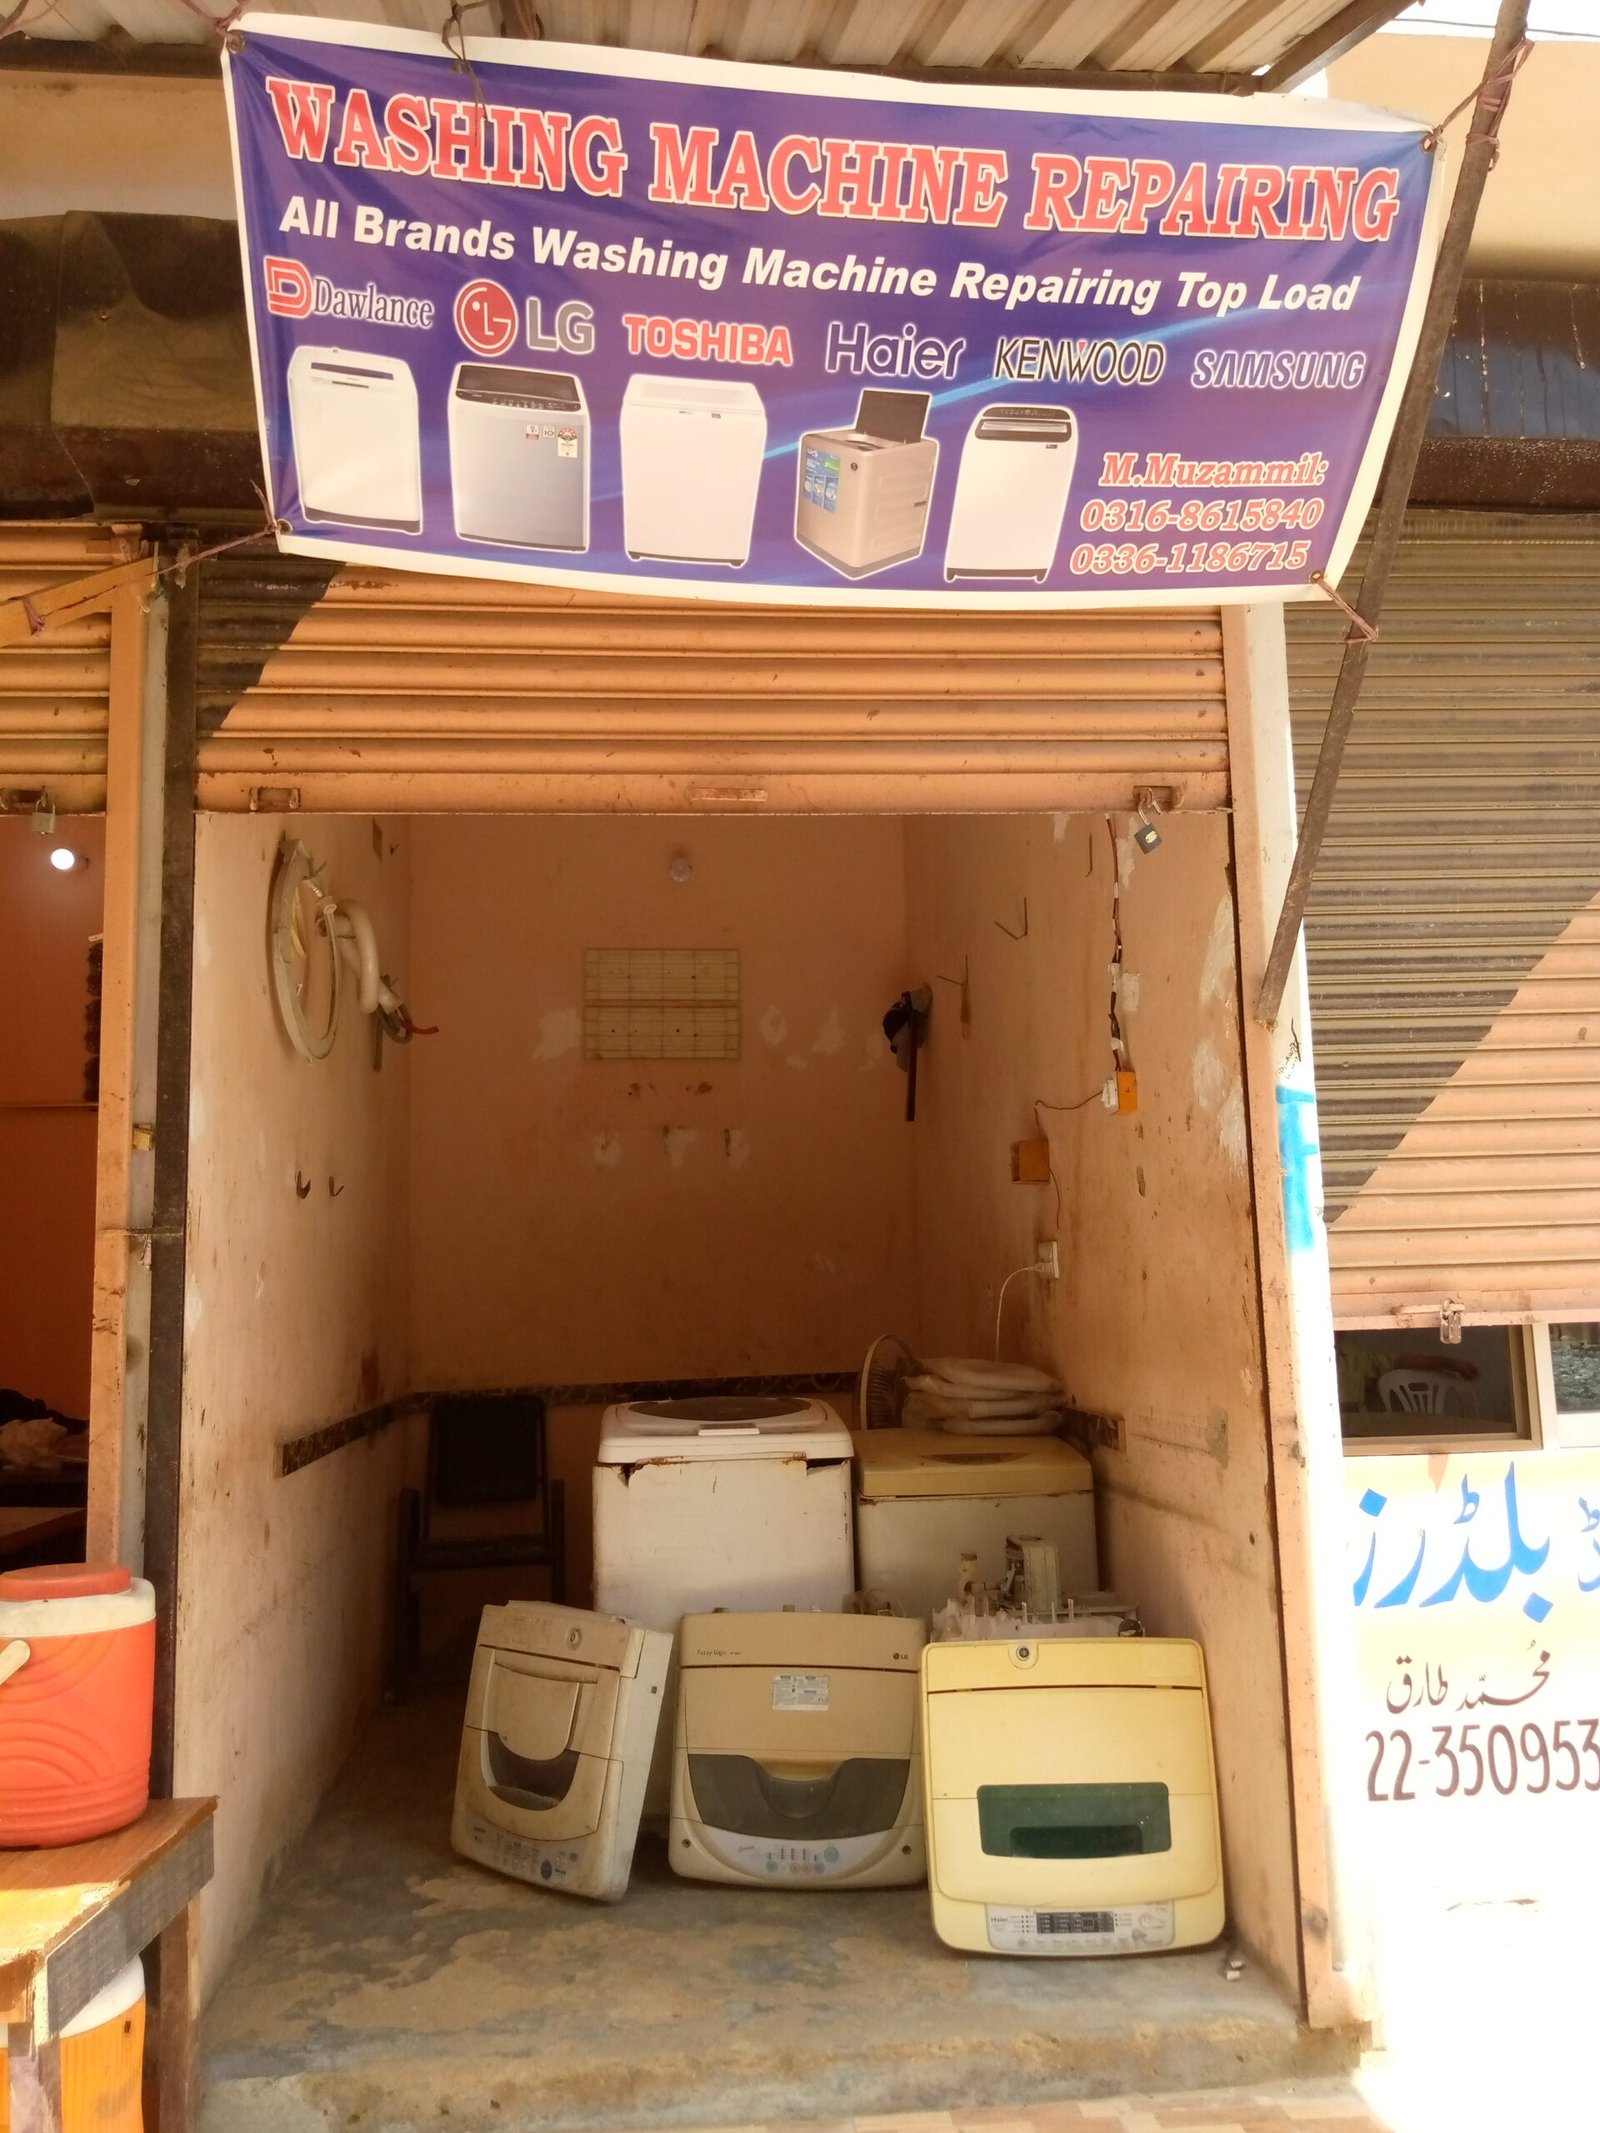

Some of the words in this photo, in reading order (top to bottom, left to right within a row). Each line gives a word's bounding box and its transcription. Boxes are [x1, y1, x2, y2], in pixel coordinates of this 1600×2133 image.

[266, 77, 627, 197] WASHING
[649, 122, 1007, 227] MACHINE
[1024, 153, 1398, 242] REPAIRING
[279, 197, 338, 239] All
[354, 207, 515, 260] Brands
[533, 227, 728, 289] Washing
[743, 248, 937, 296] Machine
[950, 262, 1161, 316] Repairing
[1176, 272, 1245, 317] Top
[1258, 276, 1361, 311] Load
[313, 278, 434, 327] Dawlance
[526, 299, 595, 354] LG
[623, 315, 793, 367] TOSHIBA
[826, 322, 965, 380] Haier
[995, 338, 1167, 384] KENWOOD
[1190, 350, 1366, 390] SAMSUNG
[1080, 499, 1324, 532] 0316-8615840
[1070, 541, 1311, 575] 0336-1186715
[1386, 1655, 1449, 1715] طارق
